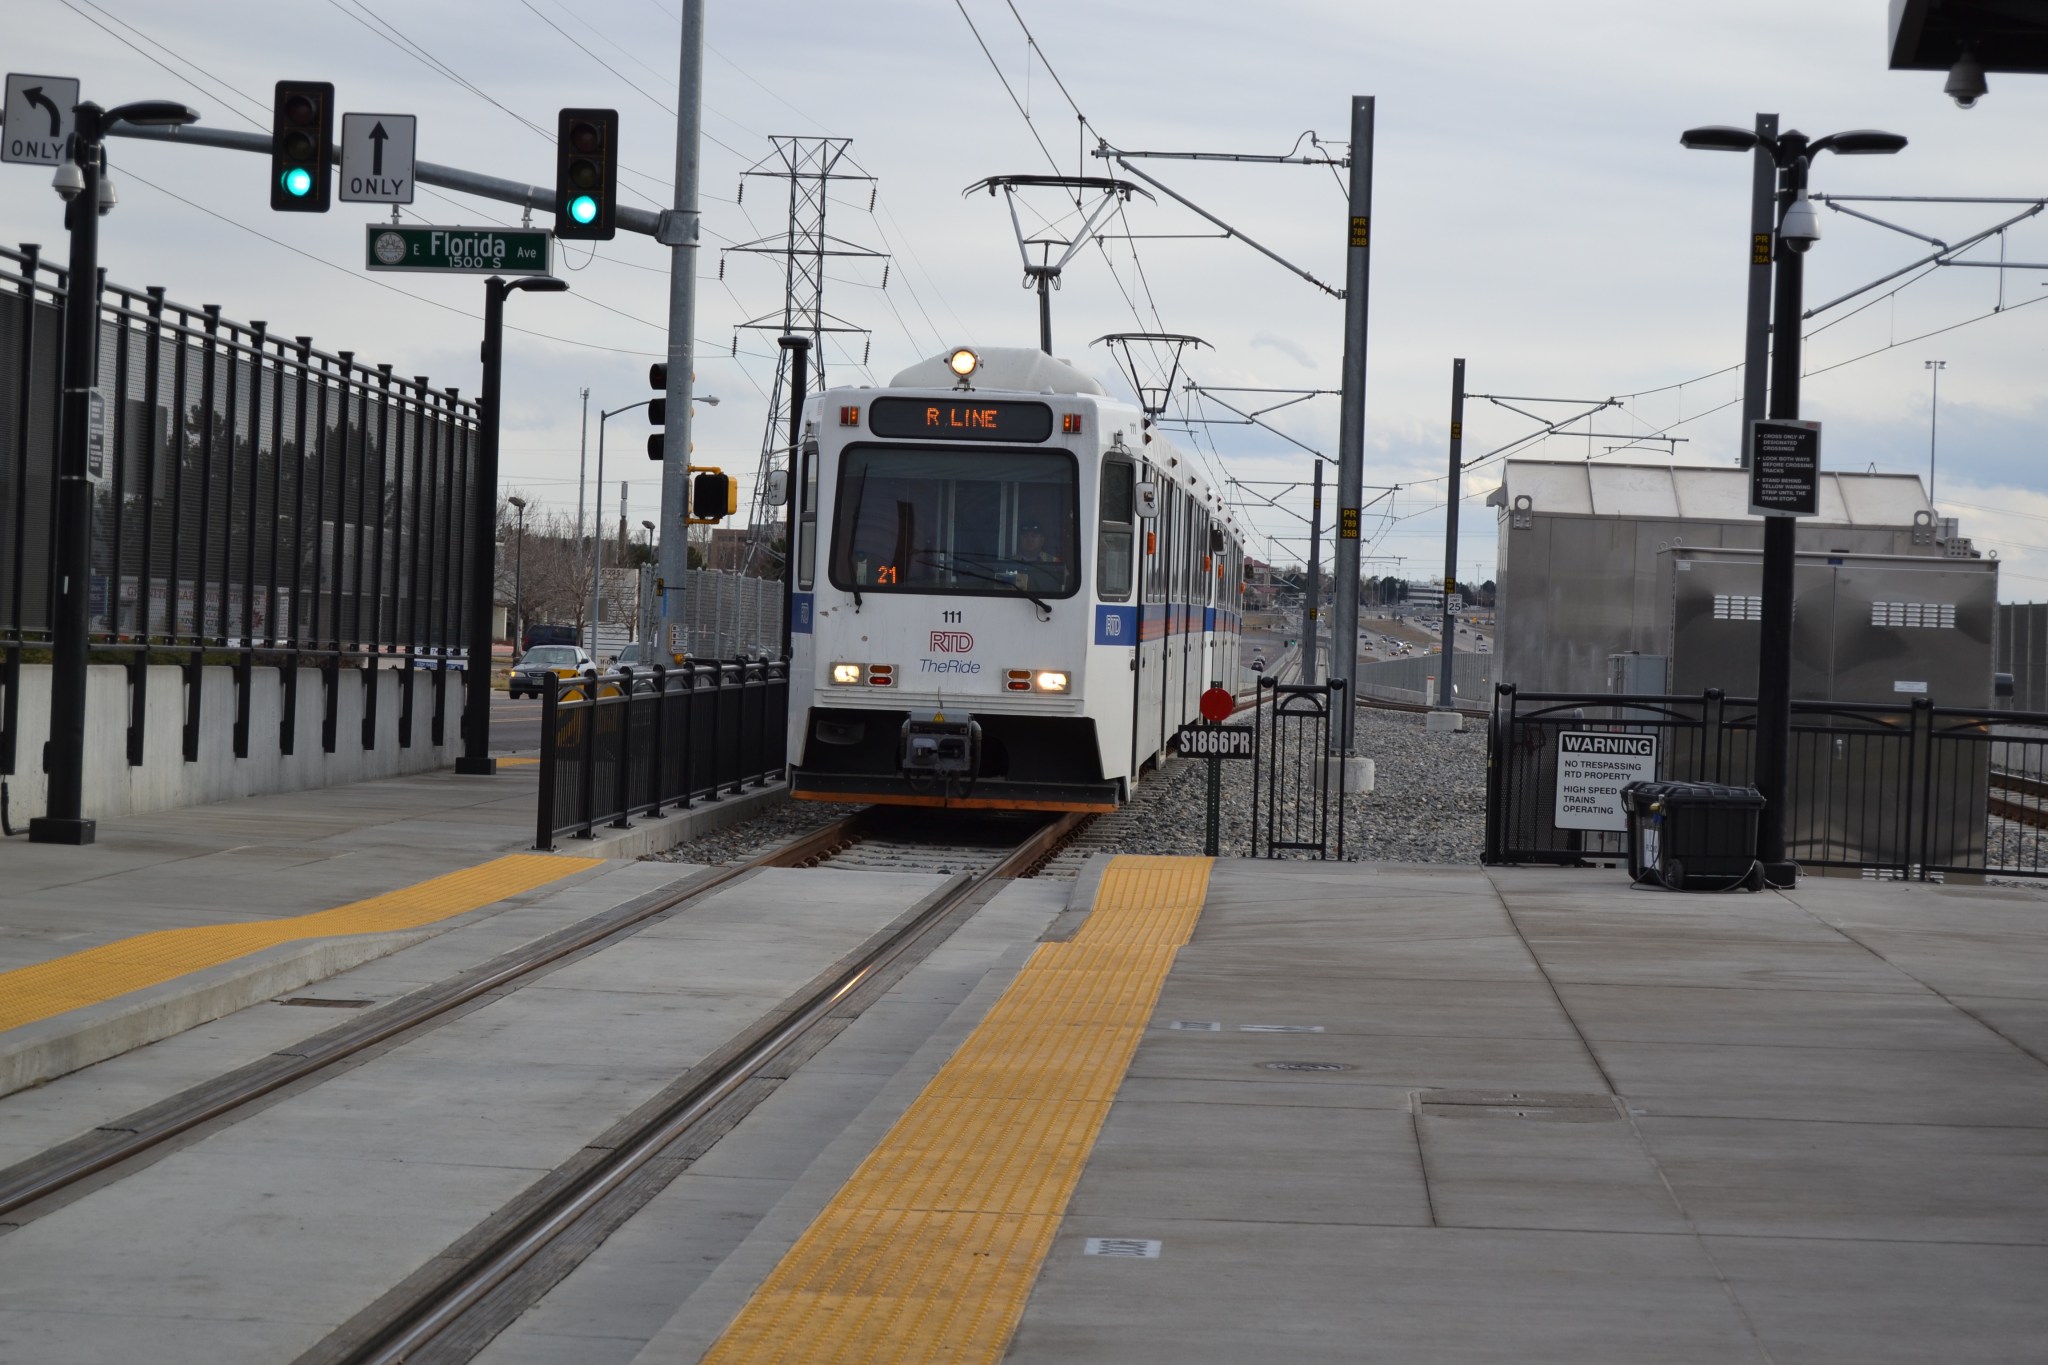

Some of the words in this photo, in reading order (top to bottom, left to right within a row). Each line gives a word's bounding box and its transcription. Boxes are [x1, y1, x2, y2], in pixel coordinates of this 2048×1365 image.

[11, 139, 63, 159] ONLY
[351, 177, 404, 197] ONLY
[1352, 217, 1366, 227] PR
[1352, 227, 1366, 237] 789
[412, 243, 420, 256] E
[430, 231, 506, 258] Florida
[516, 246, 537, 259] Ave
[1351, 236, 1367, 246] 35B
[448, 256, 483, 268] 1500
[492, 257, 502, 269] S
[926, 407, 939, 426] R
[952, 409, 998, 429] LINE
[1343, 509, 1357, 518] PR
[1342, 519, 1357, 528] 789
[1341, 528, 1358, 539] 35B
[877, 566, 898, 585] 21
[1448, 602, 1461, 611] 25
[942, 610, 962, 624] 111
[1105, 614, 1121, 637] RTD
[929, 630, 975, 654] RTD
[919, 658, 981, 675] TheRide
[1180, 730, 1250, 754] S1866PR
[1565, 736, 1651, 755] WARNING
[1564, 760, 1578, 768] NO
[1581, 761, 1642, 771] TRESPASSING
[1564, 771, 1582, 779] RTD
[1584, 772, 1632, 781] PROPERTY
[1563, 785, 1586, 794] HIGH
[1588, 787, 1617, 795] SPEED
[1563, 796, 1596, 804] TRAINS
[1563, 805, 1614, 815] OPERATING
